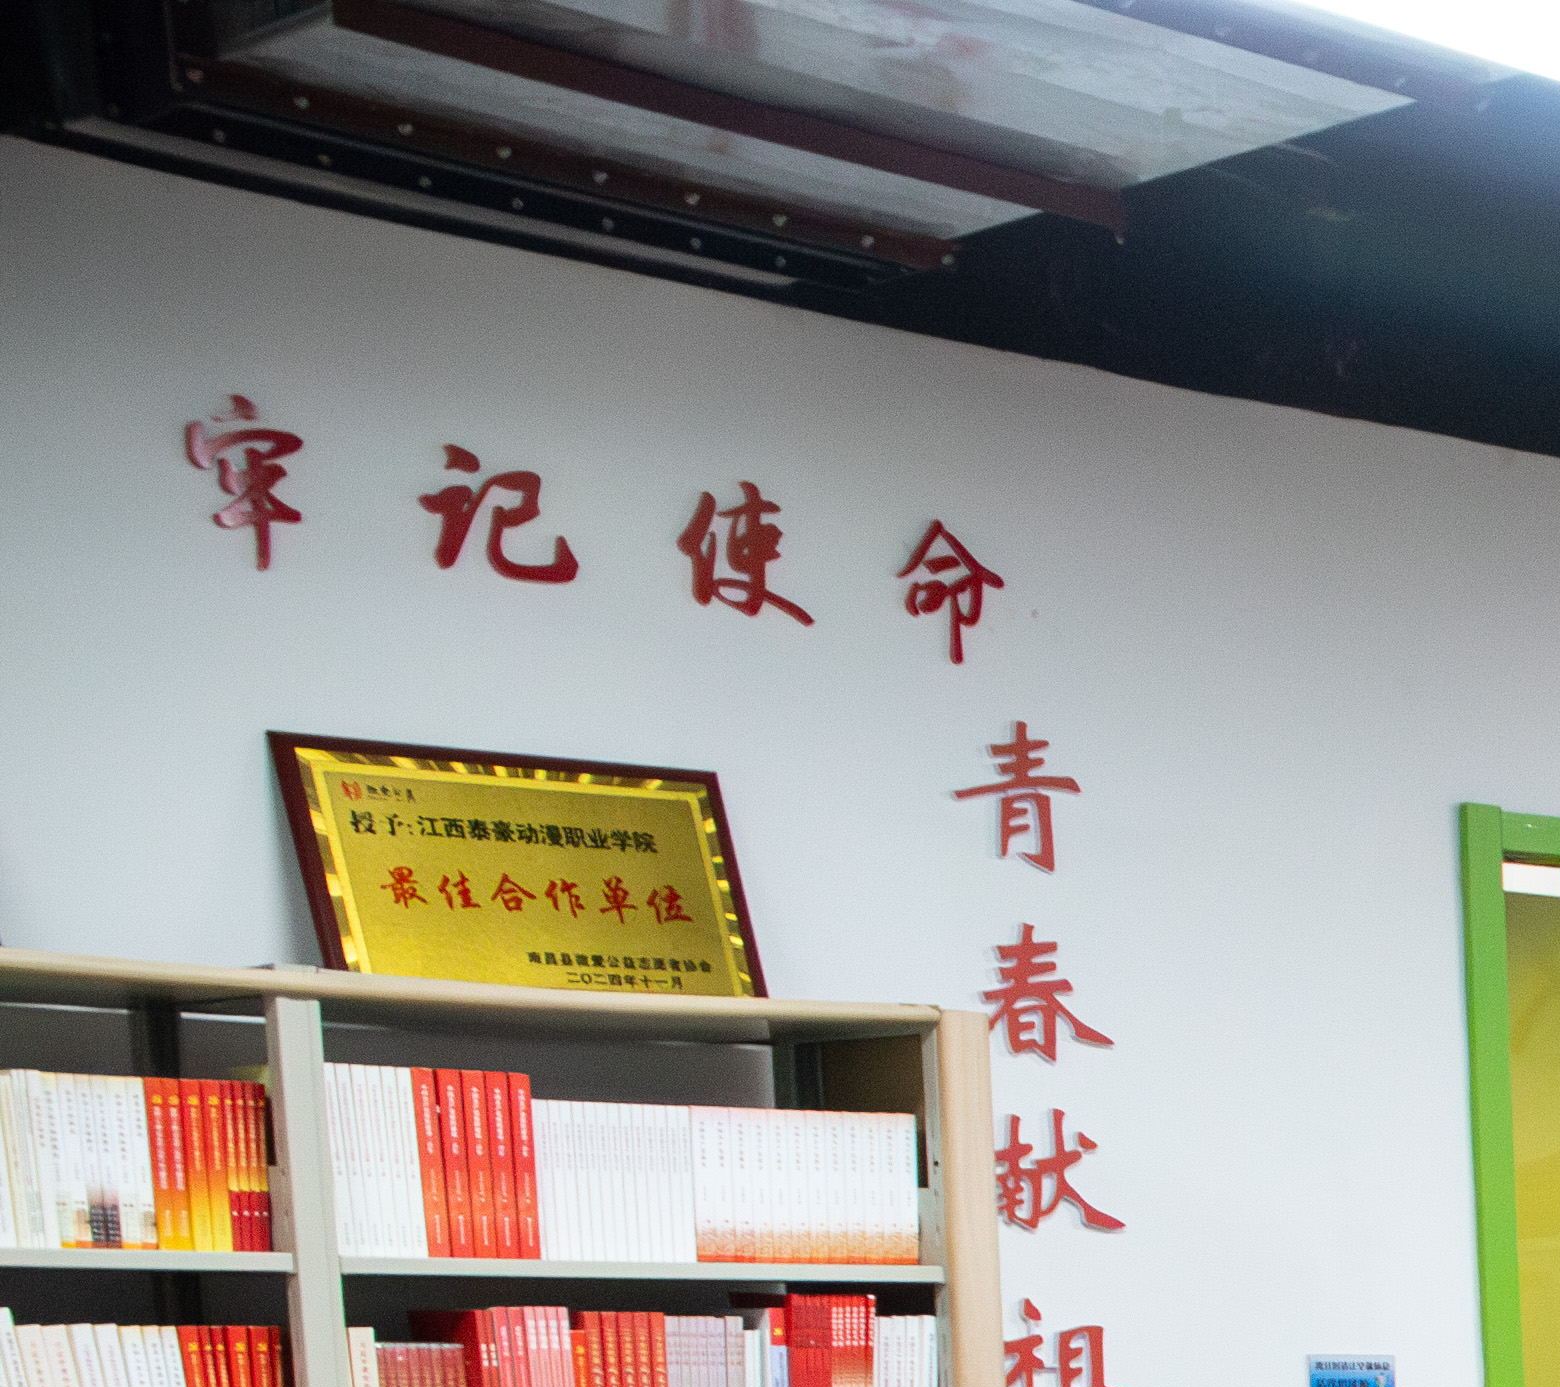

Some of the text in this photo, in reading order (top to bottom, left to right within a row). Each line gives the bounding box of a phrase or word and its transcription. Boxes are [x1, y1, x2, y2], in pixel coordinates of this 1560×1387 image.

[184, 395, 1004, 664] 牢记使命
[380, 865, 693, 924] 最佳合作单位
